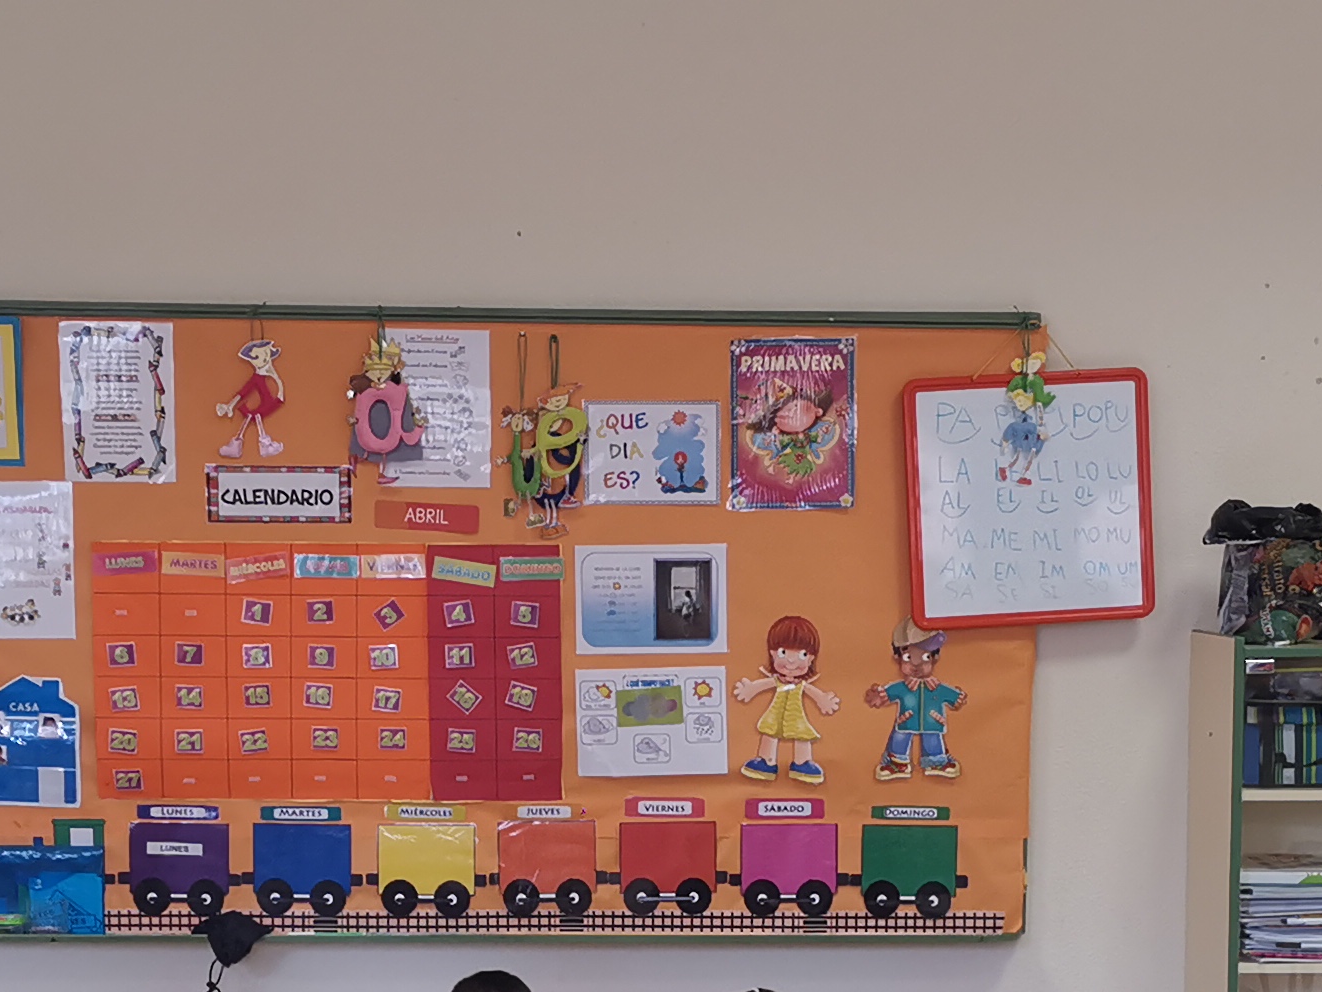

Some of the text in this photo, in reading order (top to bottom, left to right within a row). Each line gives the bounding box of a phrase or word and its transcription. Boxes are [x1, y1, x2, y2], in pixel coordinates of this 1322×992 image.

[741, 354, 846, 373] PRIMAVERA
[935, 402, 977, 434] PA
[609, 442, 644, 460] DIA
[938, 455, 970, 484] LA
[1037, 460, 1063, 483] LI
[1075, 460, 1099, 482] LO
[1107, 461, 1132, 481] LU
[603, 470, 641, 489] ES?
[220, 487, 334, 507] CALENDARIO
[404, 507, 449, 525] ABRIL
[990, 528, 1022, 551] ME
[1032, 528, 1063, 551] MI
[1073, 525, 1100, 544] MO
[1106, 526, 1132, 544] MU
[105, 556, 145, 569] LUNES
[169, 558, 218, 570] MARTES
[939, 556, 977, 580] AM
[1083, 560, 1110, 577] OM
[252, 604, 532, 624] 1 2 3 4 5
[114, 646, 535, 666] 6 7 8 9 10 11 12
[9, 702, 40, 712] CASA
[111, 687, 535, 709] 13 14 15 16 17 18 19
[110, 730, 540, 751] 20 21 22 23 24 25 26
[116, 772, 141, 789] 27
[161, 807, 194, 817] LUNES
[279, 808, 322, 817] MARTES
[399, 806, 453, 817] MIÉRCOLES
[526, 807, 561, 816] JUEVES
[644, 803, 686, 814] VIERNES
[764, 802, 804, 814] SÁBADO
[885, 807, 937, 818] DOMINGO
[160, 844, 189, 853] LUNES
